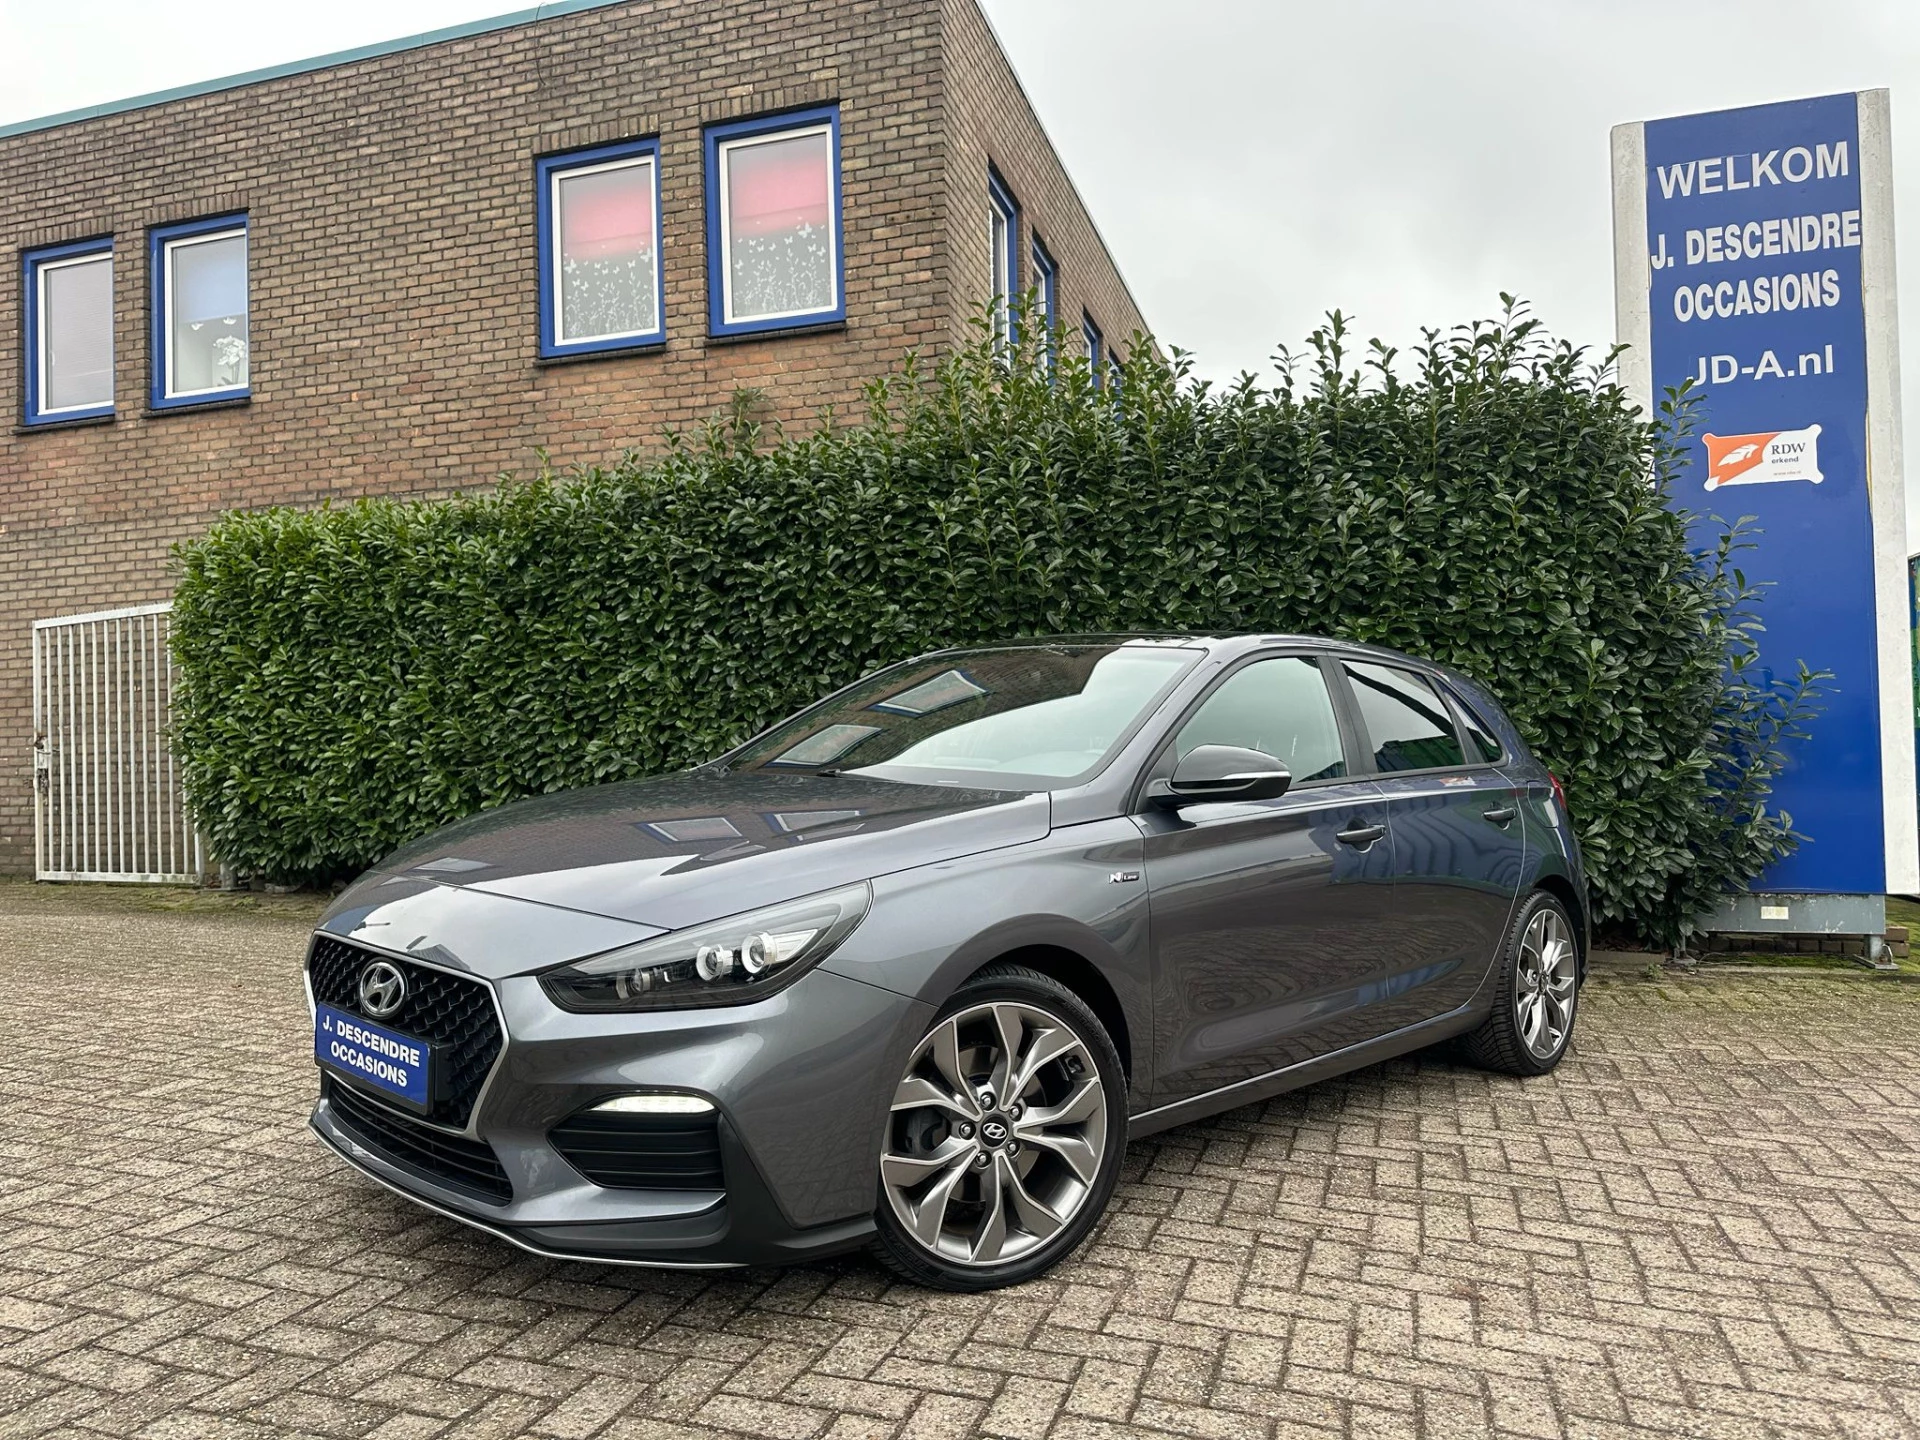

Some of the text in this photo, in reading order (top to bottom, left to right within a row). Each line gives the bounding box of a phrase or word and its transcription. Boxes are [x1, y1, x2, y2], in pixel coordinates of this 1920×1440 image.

[1656, 141, 1849, 200] WELKOM
[1651, 209, 1861, 270] J. DESCENDRE
[1674, 269, 1840, 323] OCCASIONS
[1686, 344, 1834, 386] JD-A.nl
[1771, 442, 1806, 455] RDW
[1771, 456, 1799, 464] erkend
[323, 1015, 420, 1067] J. DESCENDRE
[330, 1041, 407, 1087] OCCASIONS
